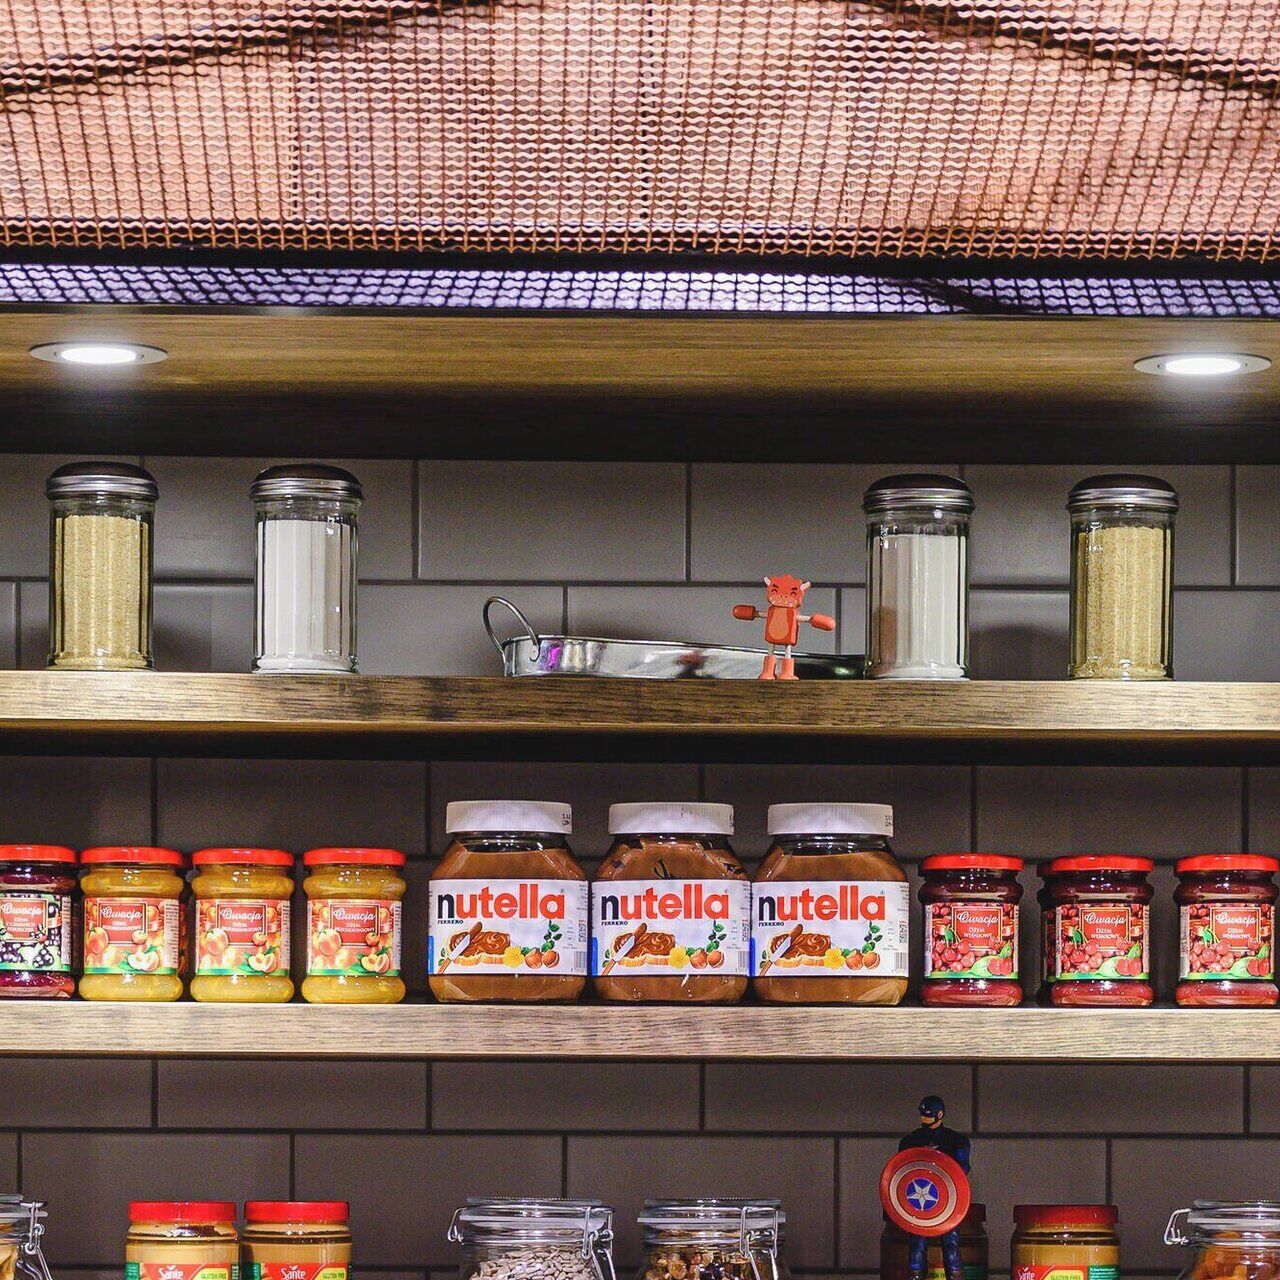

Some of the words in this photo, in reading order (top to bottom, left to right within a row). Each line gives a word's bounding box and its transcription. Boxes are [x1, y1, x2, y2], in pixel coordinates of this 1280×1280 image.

[435, 883, 566, 920] nutella
[600, 884, 731, 921] nutella
[758, 885, 886, 922] nutella
[956, 912, 999, 926] Owacja
[1083, 912, 1128, 926] Owacja
[1215, 912, 1258, 926] Owacja
